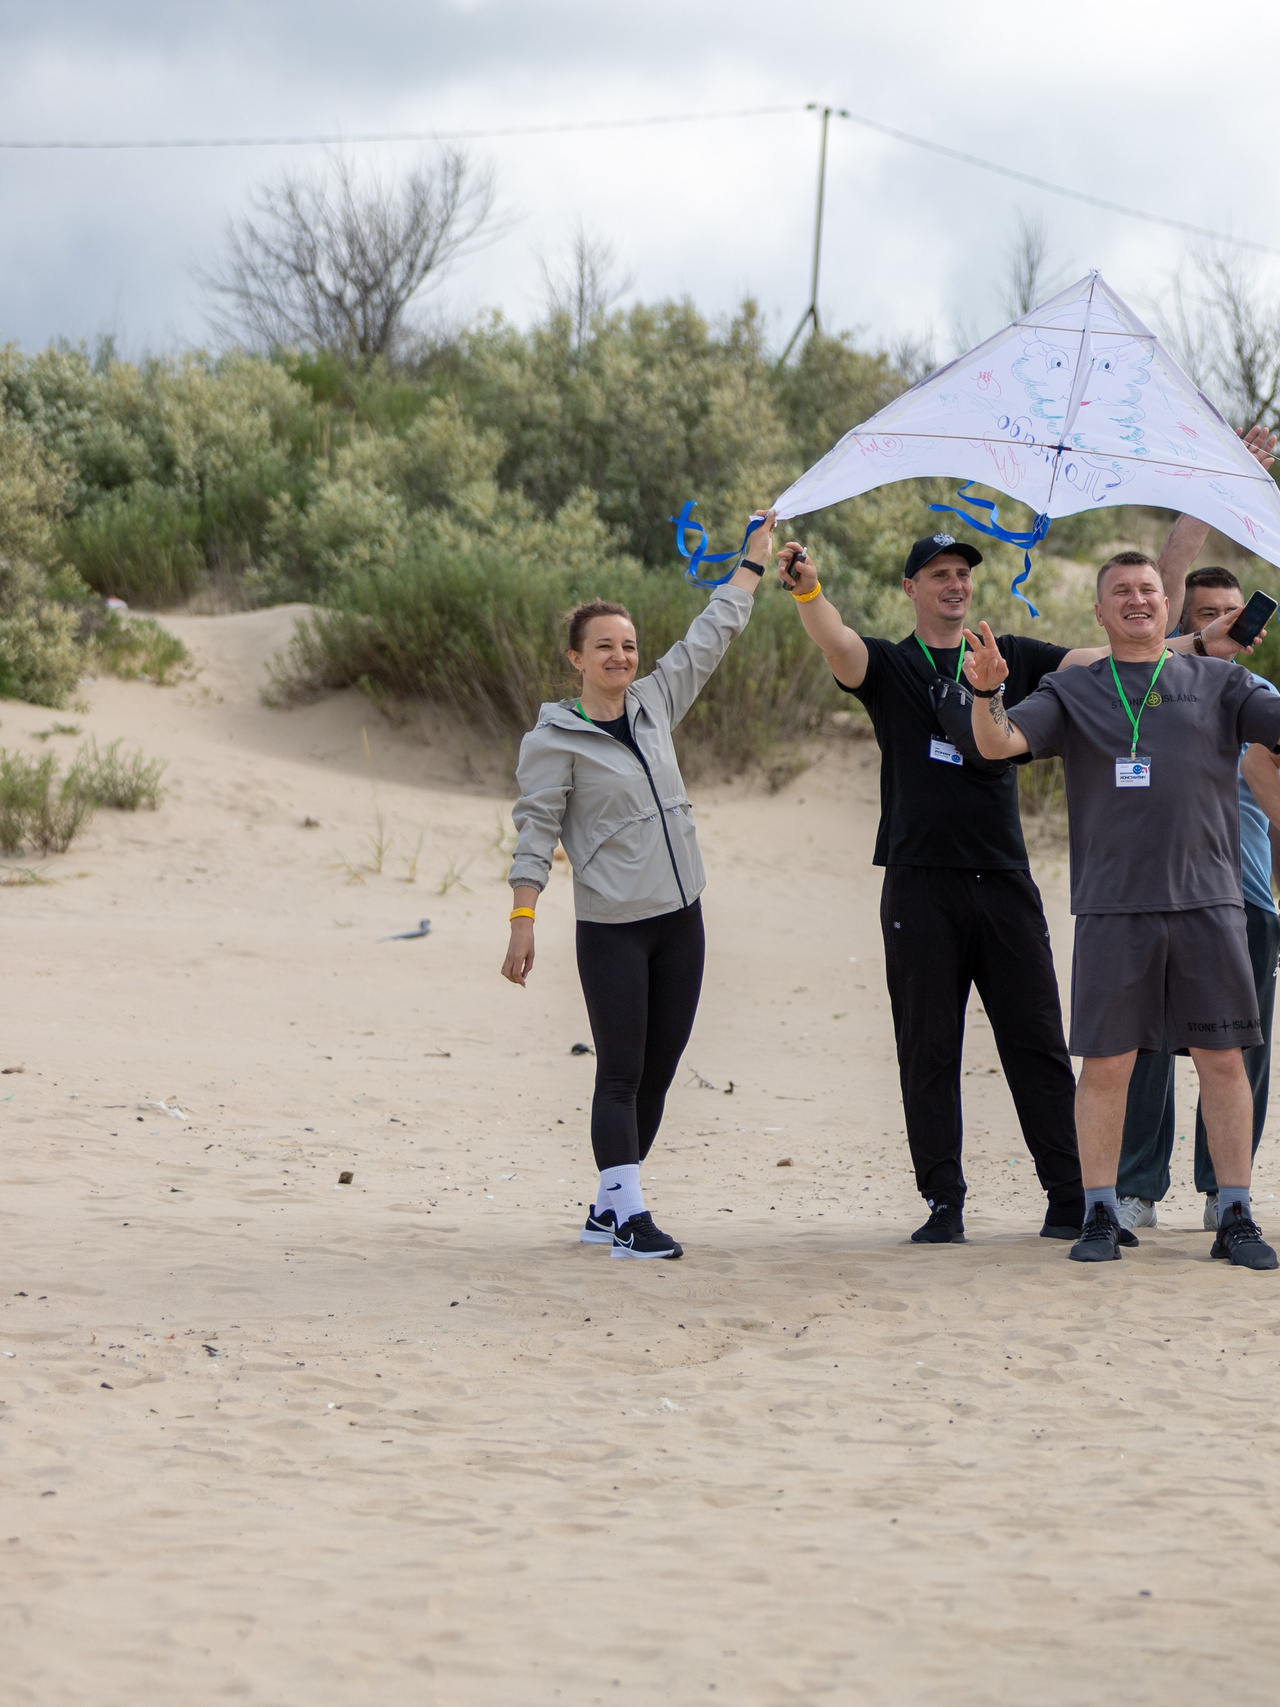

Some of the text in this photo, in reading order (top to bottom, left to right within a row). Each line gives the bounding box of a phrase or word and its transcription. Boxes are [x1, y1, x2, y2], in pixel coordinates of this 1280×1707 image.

[1162, 692, 1197, 703] ISLAND
[1187, 1018, 1261, 1032] STONE ISLAN
